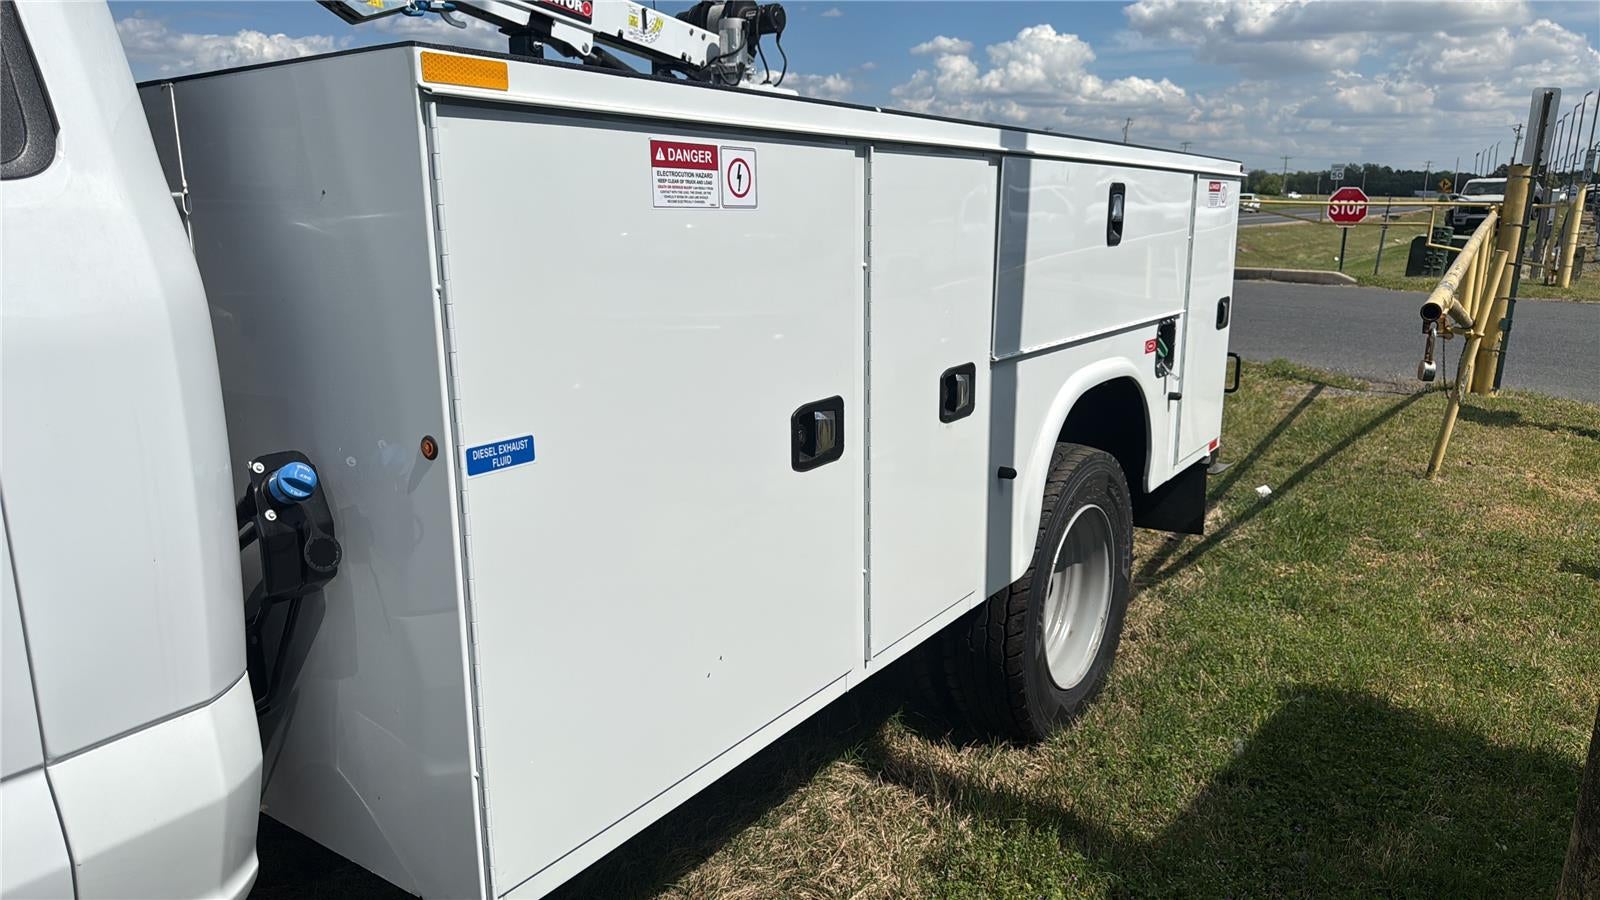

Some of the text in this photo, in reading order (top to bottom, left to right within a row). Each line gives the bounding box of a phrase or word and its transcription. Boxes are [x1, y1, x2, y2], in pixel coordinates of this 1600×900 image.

[668, 148, 712, 164] DANGER
[1330, 200, 1365, 215] STOP
[472, 439, 528, 460] DIESEL EXHAUST
[492, 455, 512, 468] FLUID
